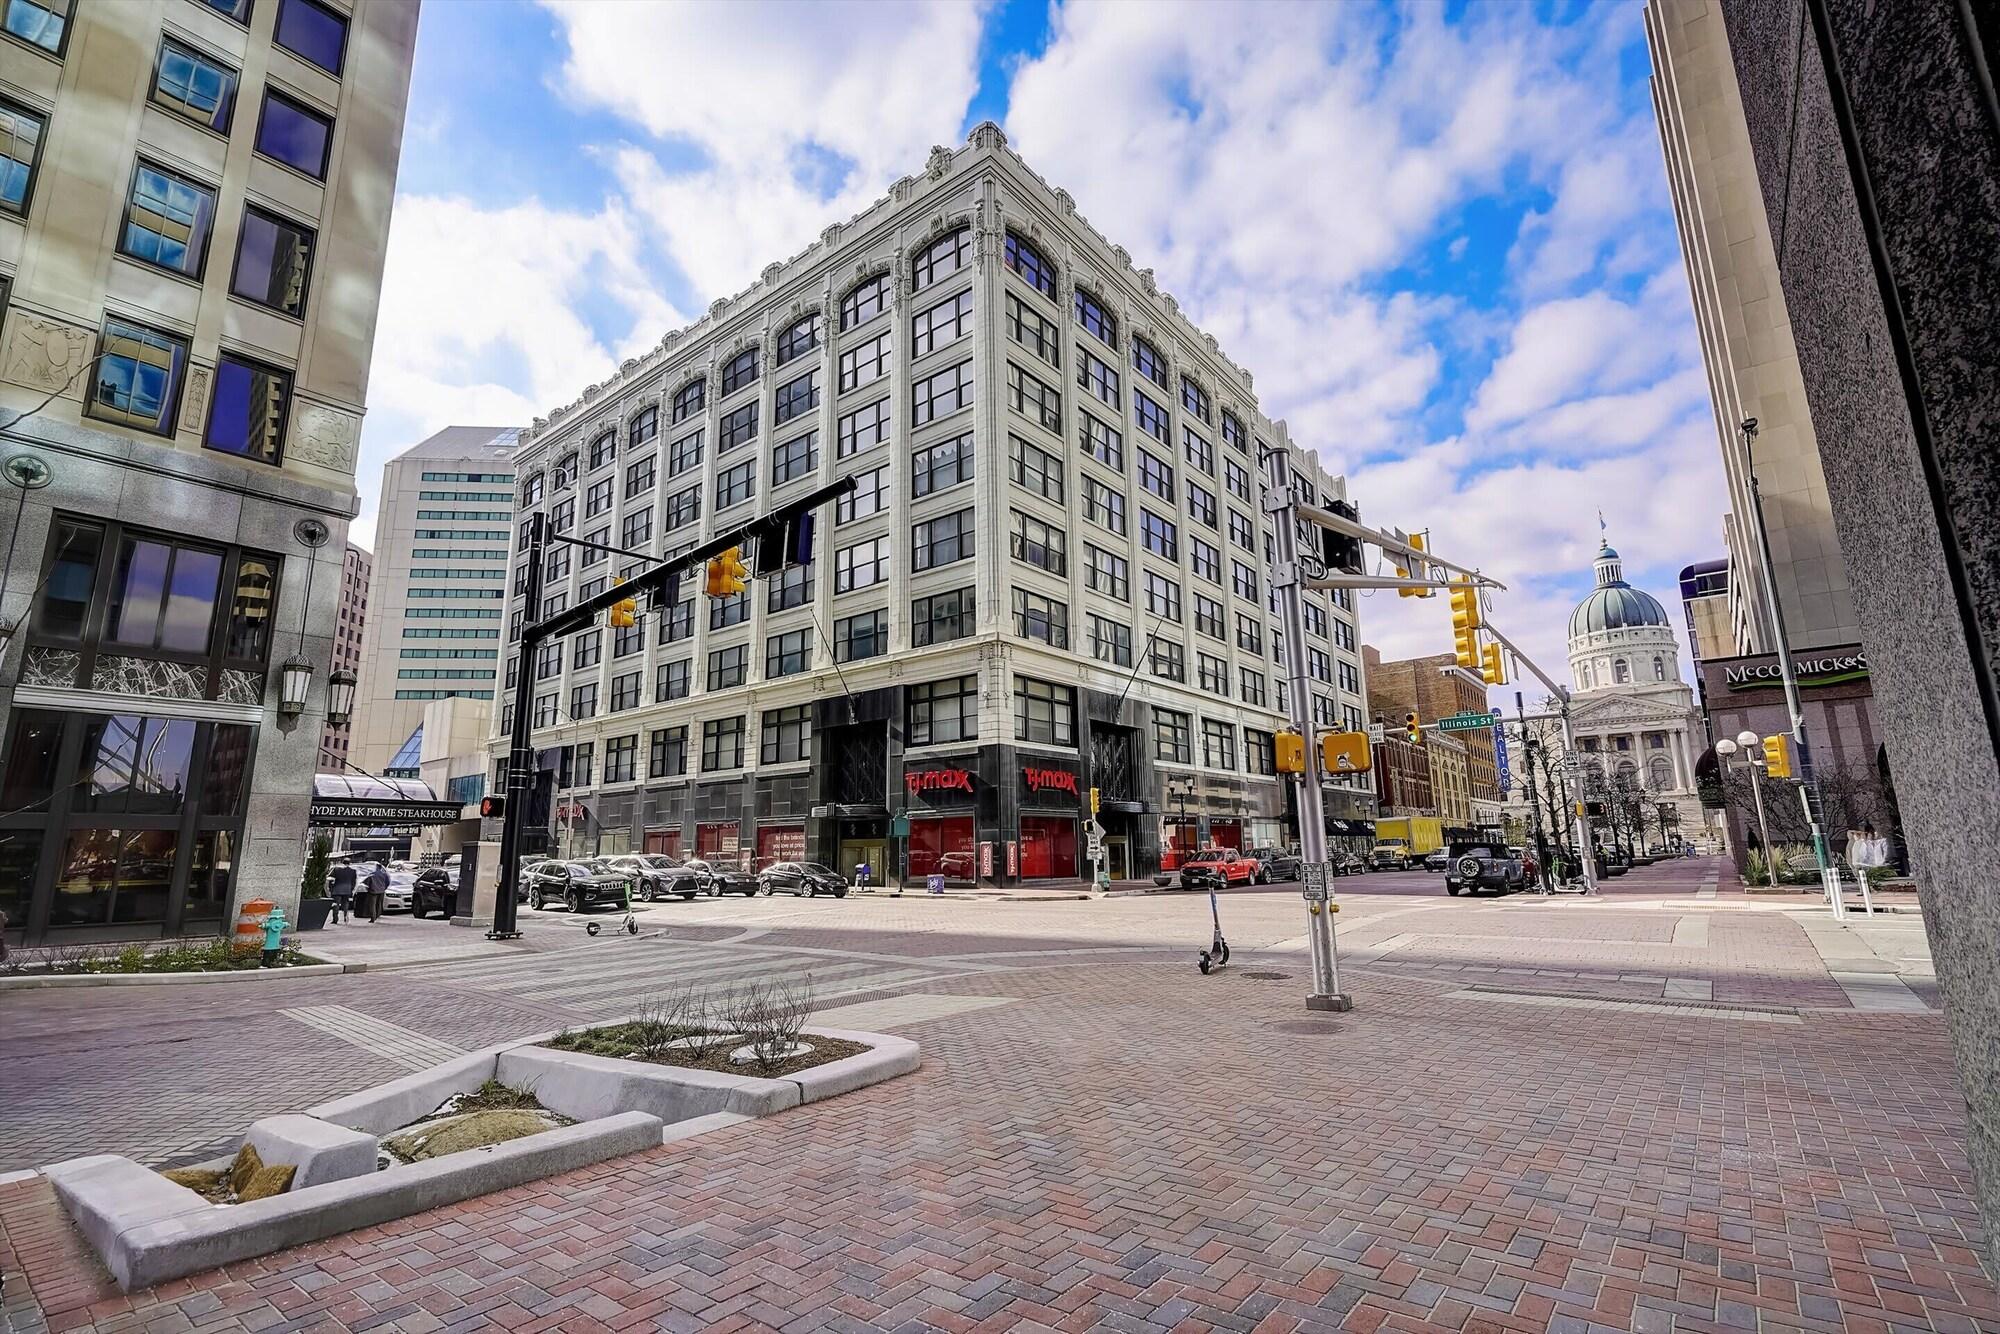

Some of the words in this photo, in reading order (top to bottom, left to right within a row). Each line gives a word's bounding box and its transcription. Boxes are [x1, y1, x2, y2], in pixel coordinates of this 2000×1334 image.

[1441, 718, 1477, 729] Illinois
[337, 806, 365, 816] PARK
[366, 807, 396, 817] PRIME
[397, 808, 456, 819] STEAKHOUSE
